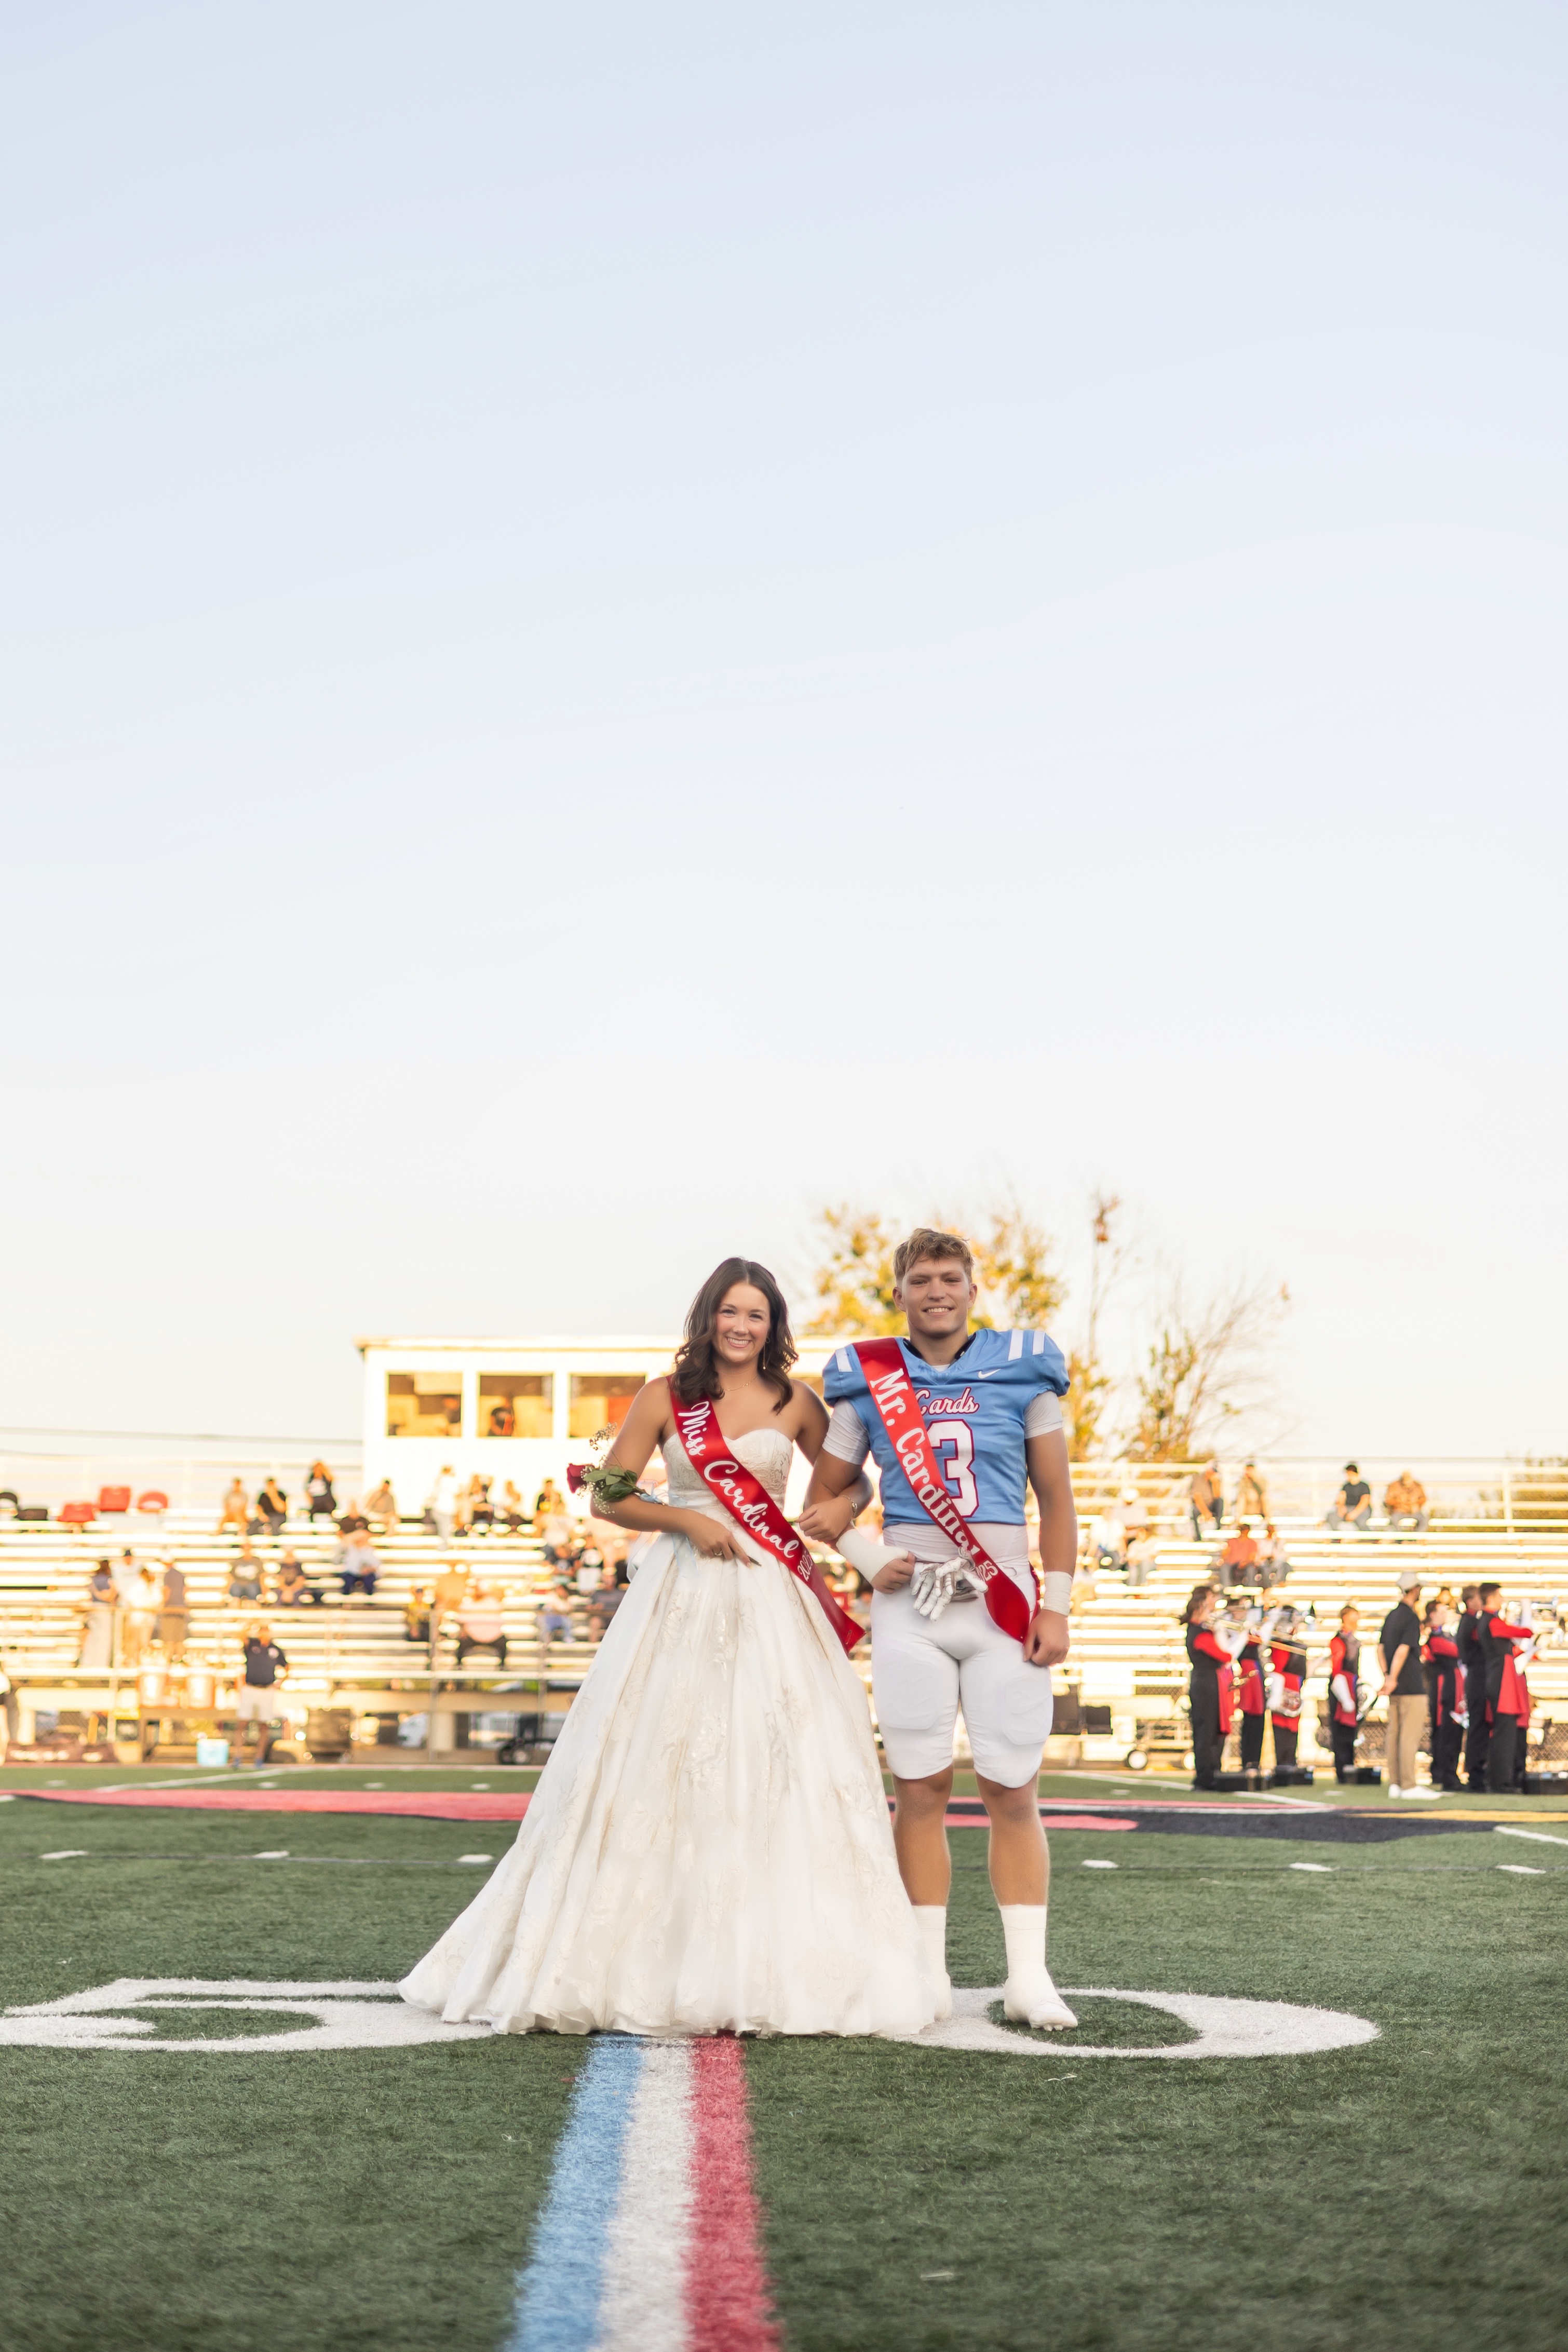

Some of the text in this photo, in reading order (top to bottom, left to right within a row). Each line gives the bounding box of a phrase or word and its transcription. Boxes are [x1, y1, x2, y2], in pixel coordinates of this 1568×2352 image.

[915, 1386, 980, 1415] Cards
[678, 1401, 711, 1456] Miss
[704, 1460, 800, 1559] Cardinal
[869, 1368, 909, 1427] Mr.
[976, 1560, 998, 1581] 025
[926, 1418, 980, 1518] 3
